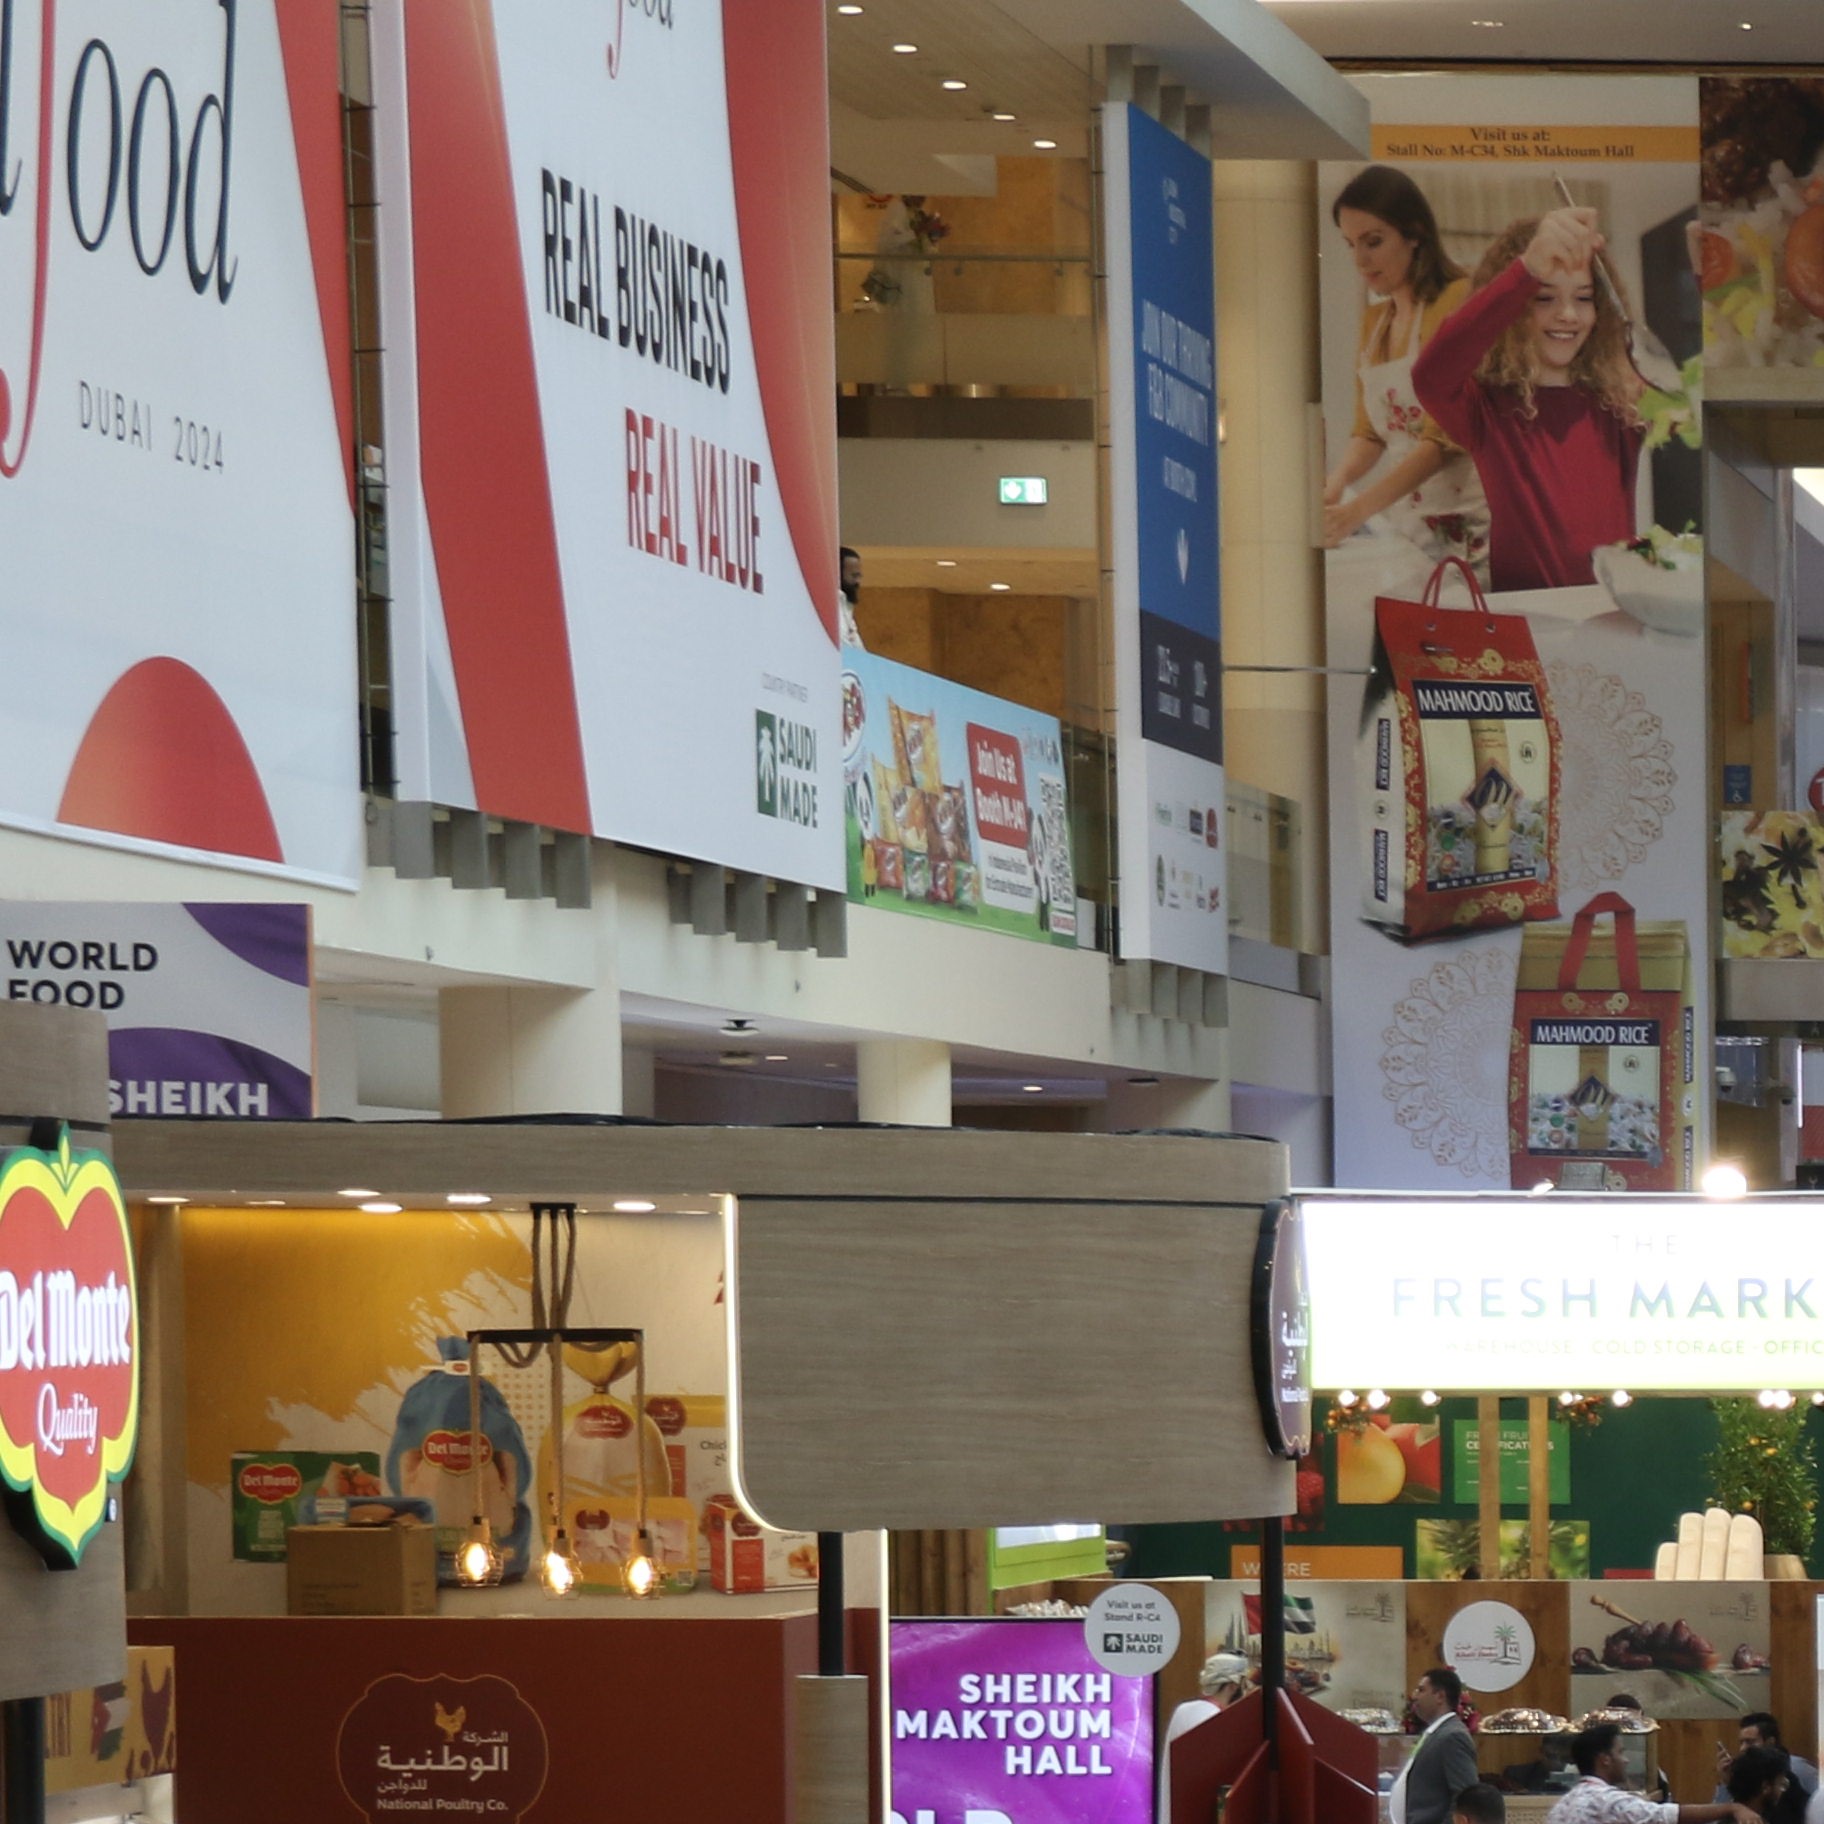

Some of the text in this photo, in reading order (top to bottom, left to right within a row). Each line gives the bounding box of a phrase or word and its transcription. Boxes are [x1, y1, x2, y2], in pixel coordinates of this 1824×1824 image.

[540, 167, 730, 394] REAL BUSINESS
[79, 379, 222, 474] DUBAI 2024
[625, 406, 764, 595] REAL VALUE
[1418, 687, 1535, 714] MAHMOOD RICE
[778, 718, 817, 772] SAUDI
[778, 775, 818, 829] MADE
[7, 941, 158, 971] WORLD
[9, 980, 126, 1010] FOOD
[1536, 1022, 1650, 1044] MAHMOOD RICE
[1610, 1233, 1680, 1257] THE
[1392, 1277, 1599, 1320] FRESH
[47, 1270, 131, 1369] Monte
[1591, 1337, 1648, 1357] COLD
[1654, 1337, 1744, 1357] STORAGE
[38, 1383, 98, 1456] Quality
[1104, 1611, 1161, 1622] Stand R-C4
[1107, 1600, 1156, 1610] Visit us at
[1126, 1633, 1164, 1643] SAUDI
[1126, 1645, 1163, 1654] MADE
[959, 1672, 1113, 1705] SHEIKH
[462, 1731, 509, 1744] الشركة
[895, 1709, 1113, 1740] MAKTOUM
[376, 1743, 509, 1781] الوطنية
[1005, 1744, 1112, 1776] HALL
[376, 1799, 509, 1814] National Poultry Co.
